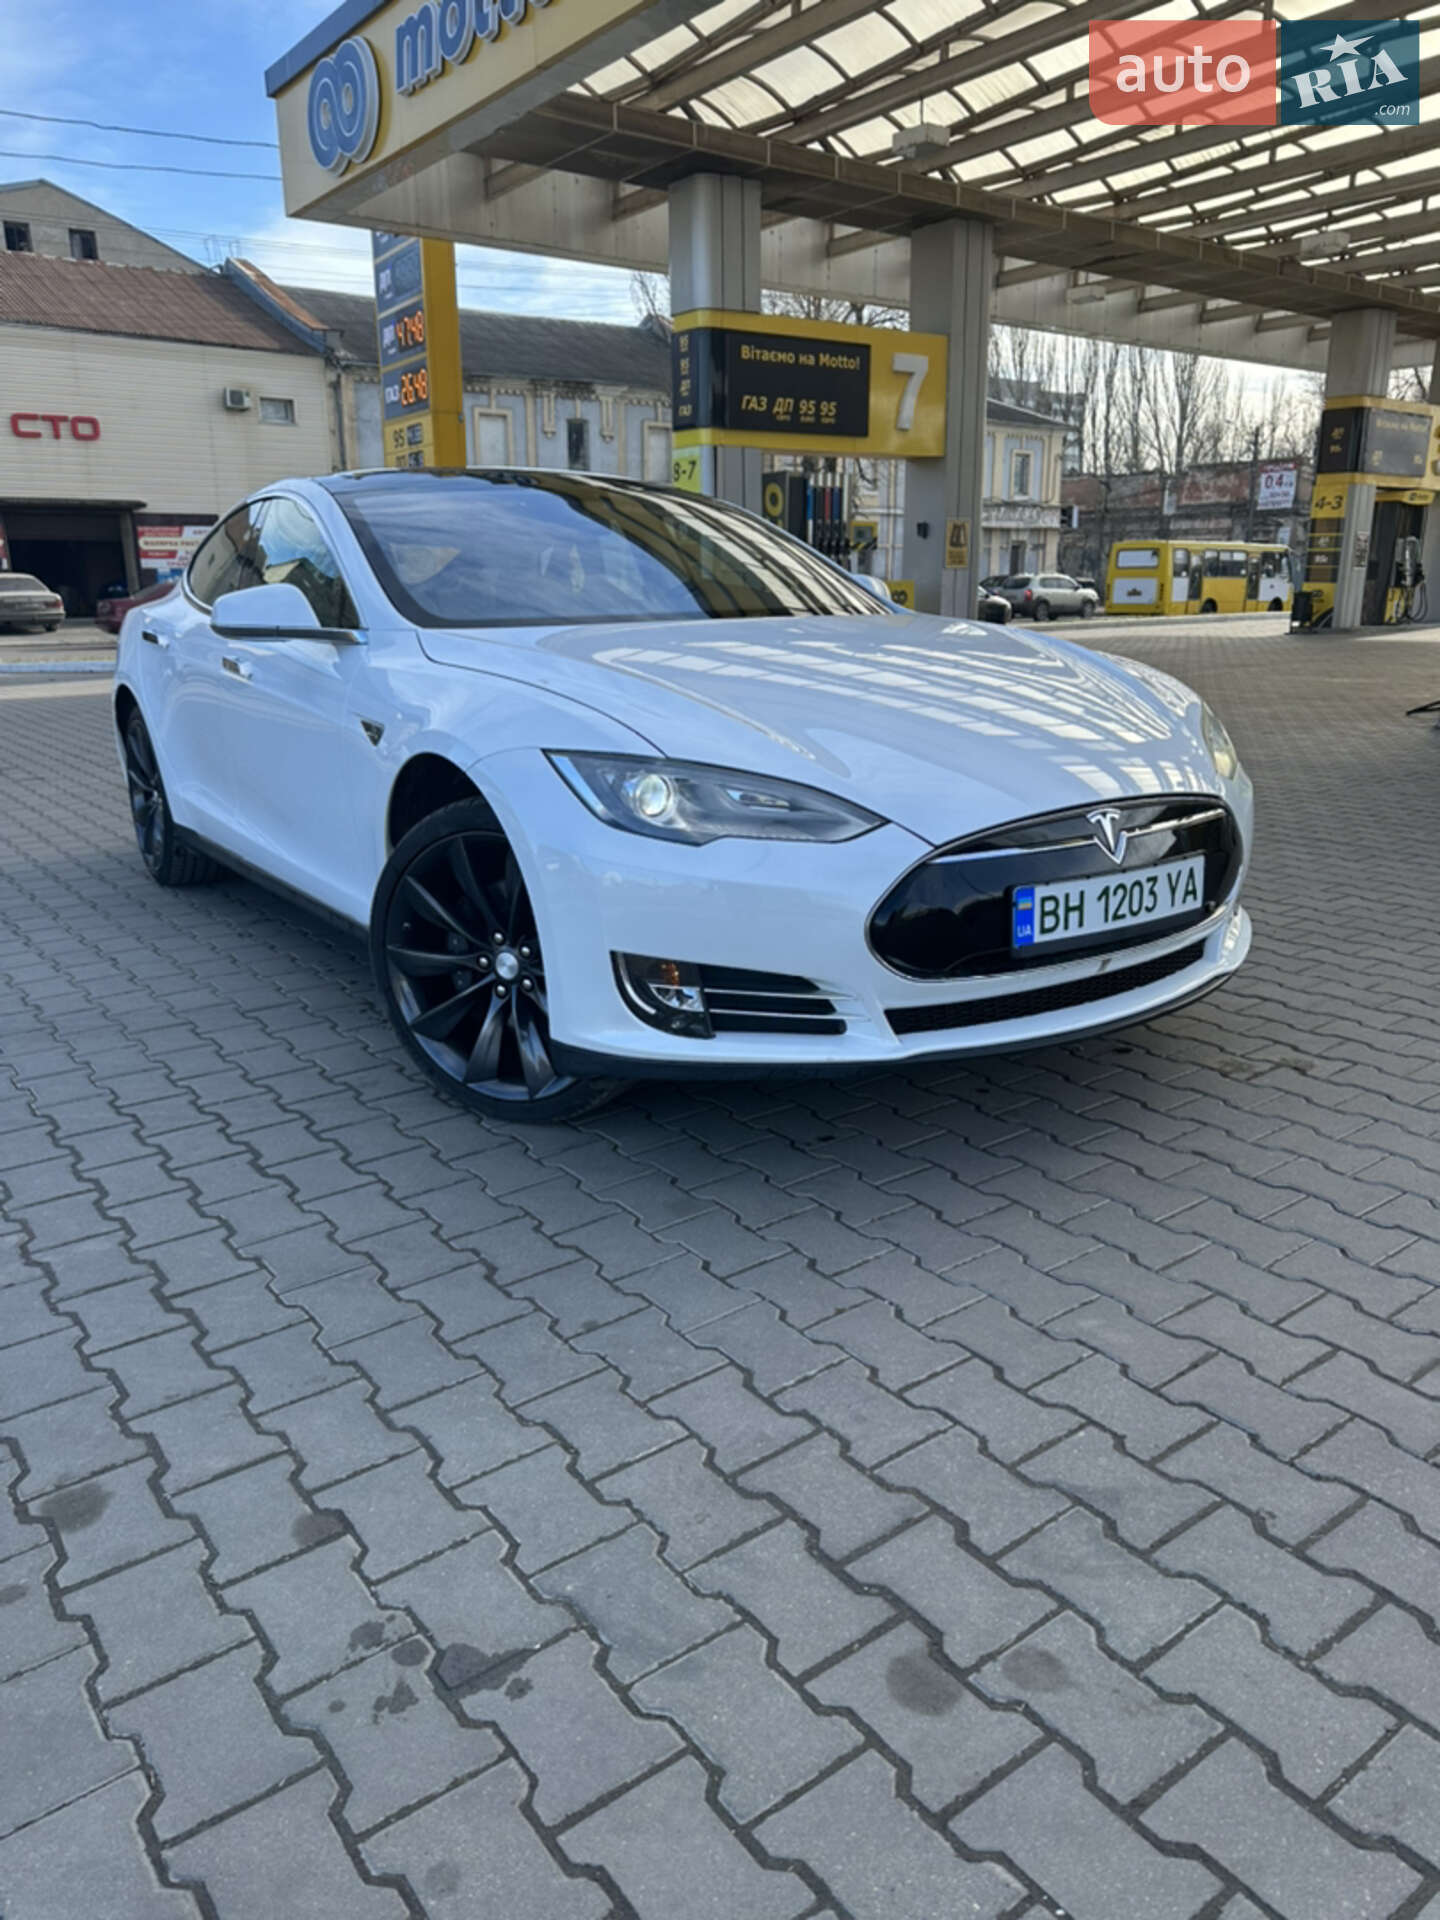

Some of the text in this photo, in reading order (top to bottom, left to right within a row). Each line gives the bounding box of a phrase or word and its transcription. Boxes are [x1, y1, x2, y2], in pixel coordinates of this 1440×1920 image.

[740, 344, 860, 370] Вітаємо на Motto!
[891, 352, 929, 430] 7
[741, 394, 838, 417] ГАЗ ДП 95 95
[10, 413, 100, 441] СТО
[1315, 495, 1343, 511] 4-3
[1040, 866, 1198, 935] BH 1203 YA
[1017, 925, 1033, 937] UA
